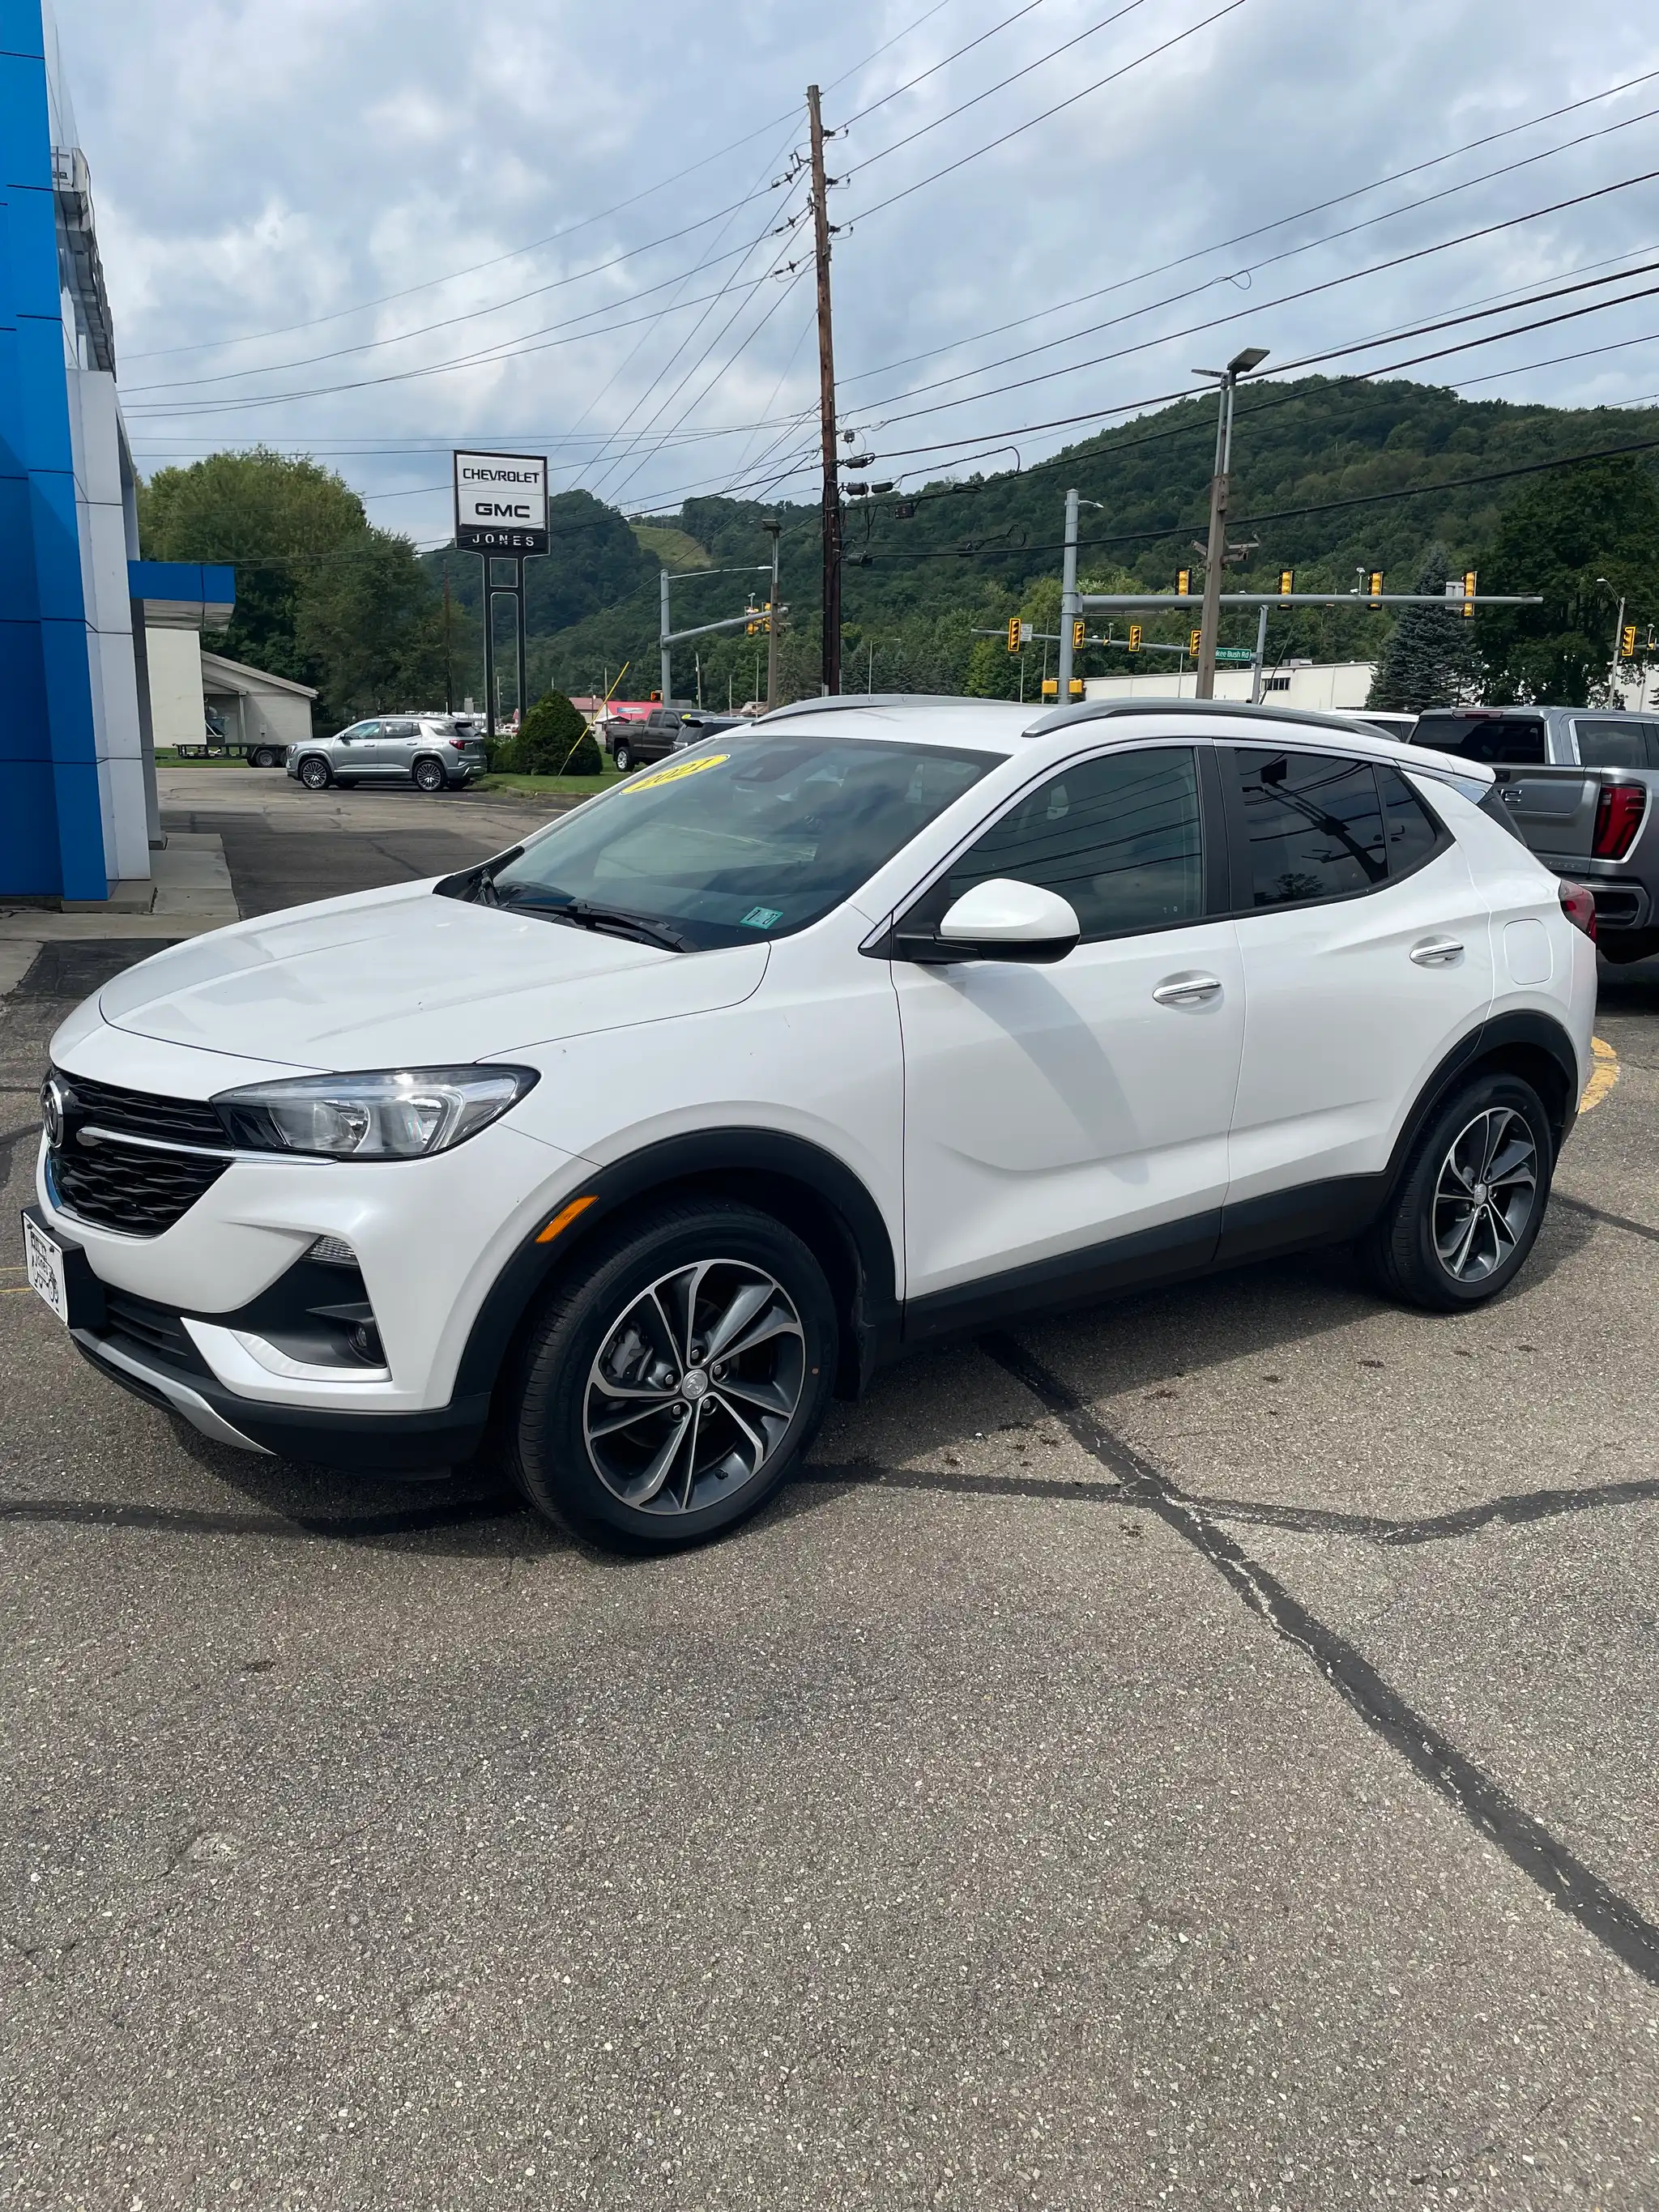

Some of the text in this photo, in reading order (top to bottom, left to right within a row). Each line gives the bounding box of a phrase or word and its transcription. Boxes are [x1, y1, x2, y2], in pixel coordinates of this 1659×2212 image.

[463, 467, 539, 484] CHEVROLET
[475, 502, 531, 518] GMC
[471, 534, 535, 547] JONES
[1227, 650, 1241, 658] Bush
